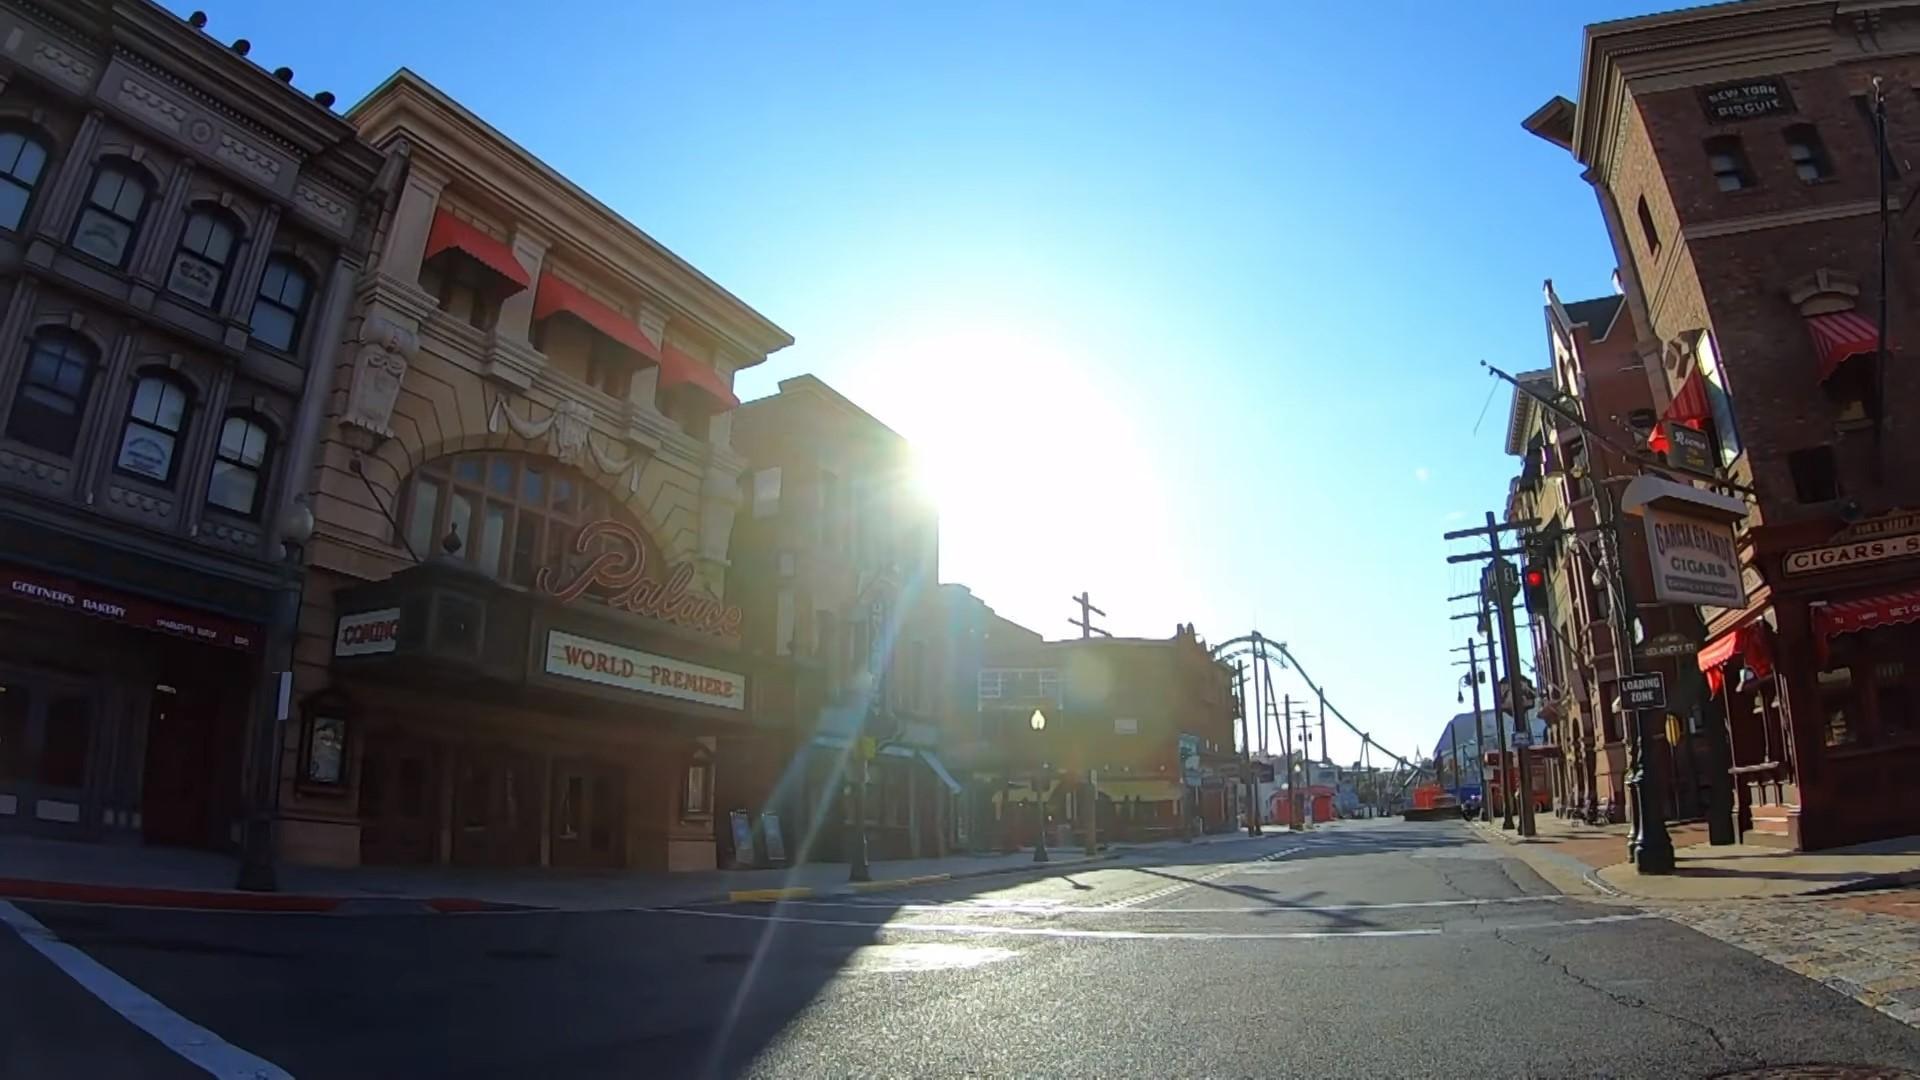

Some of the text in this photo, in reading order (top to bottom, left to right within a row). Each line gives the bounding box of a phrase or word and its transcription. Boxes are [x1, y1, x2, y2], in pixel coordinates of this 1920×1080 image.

[1742, 85, 1777, 97] YORK
[1717, 99, 1780, 117] BISCUIT
[1794, 543, 1884, 568] CIGARS
[1671, 556, 1727, 578] CIGARS
[536, 520, 743, 641] Palace
[82, 599, 127, 617] BAKERY
[564, 645, 735, 698] WORLD PREMIERE
[1622, 677, 1660, 692] LOADING
[1631, 691, 1655, 703] ZONE
